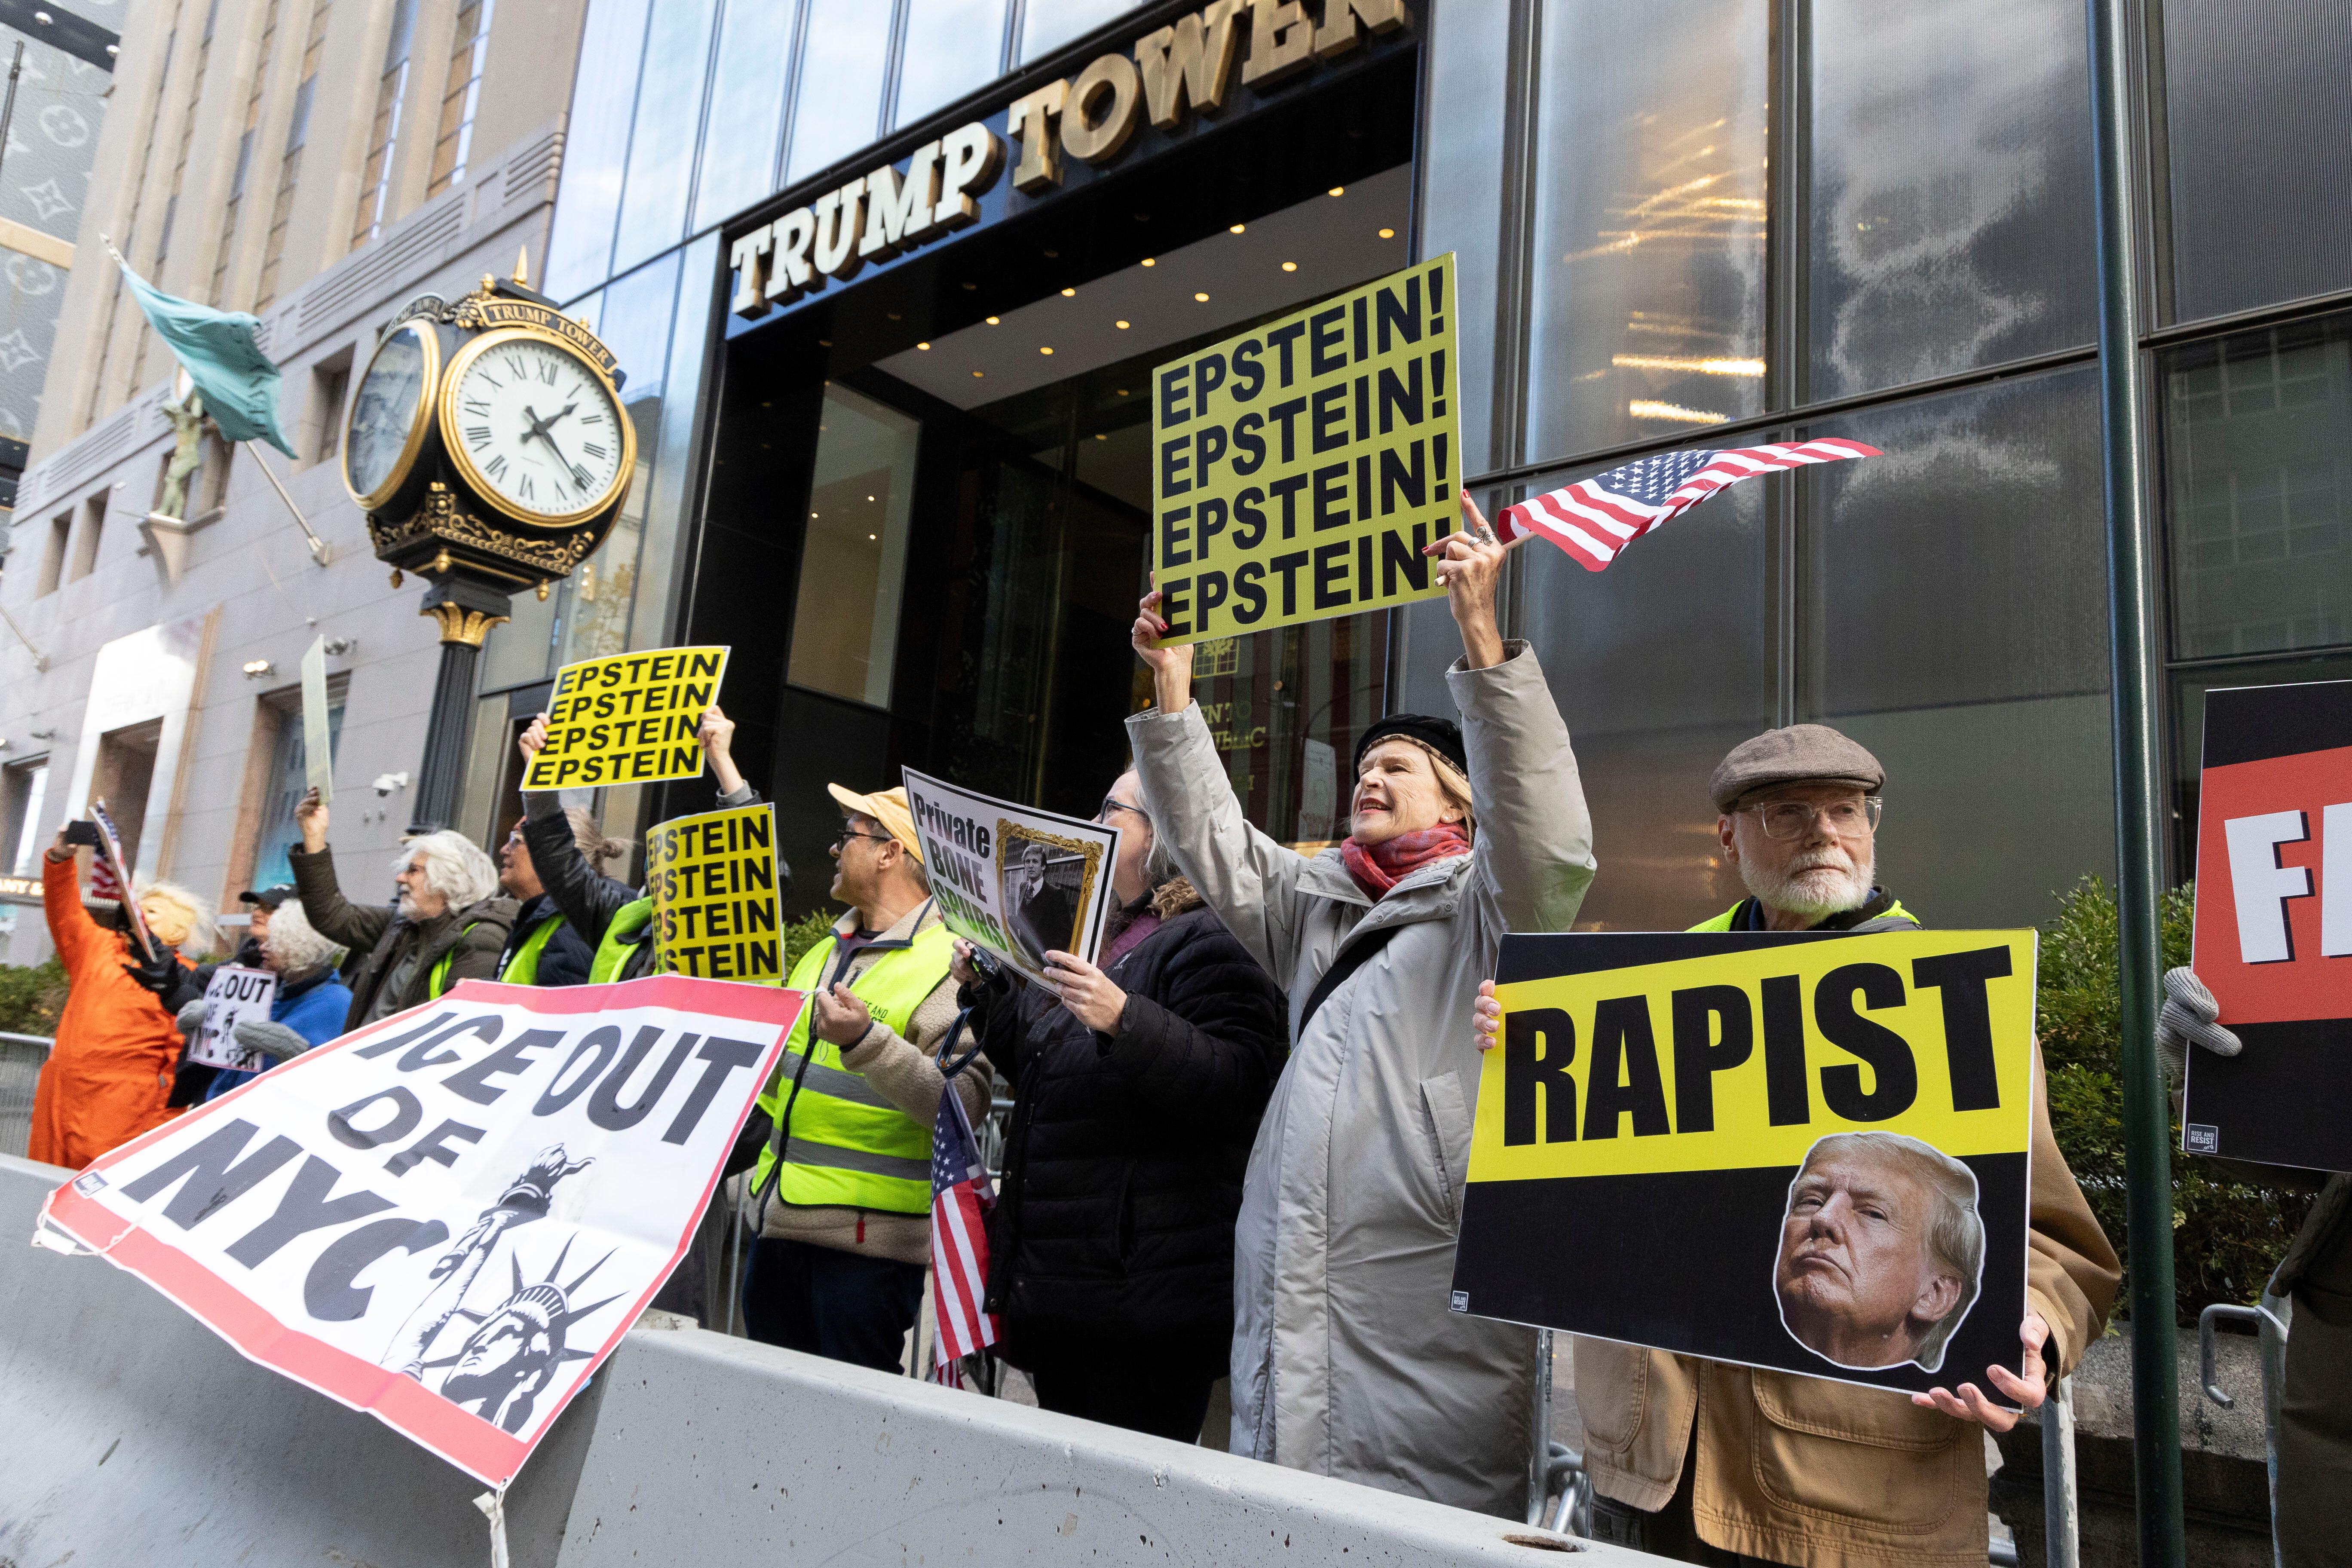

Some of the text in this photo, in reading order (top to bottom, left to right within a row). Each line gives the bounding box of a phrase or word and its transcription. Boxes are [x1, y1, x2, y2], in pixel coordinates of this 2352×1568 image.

[730, 122, 1004, 320] TRUMP
[488, 305, 610, 364] TRUMP TOWER
[1160, 266, 1444, 430] EPSTEIN!
[1161, 349, 1447, 499] EPSTEIN!
[1161, 432, 1449, 569] EPSTEIN!
[549, 683, 713, 725] EPSTEIN
[556, 653, 720, 696] EPSTEIN
[529, 745, 699, 786] EPSTEIN
[539, 713, 702, 756] EPSTEIN
[647, 814, 769, 869] EPSTEIN
[913, 791, 990, 859] Private
[29, 882, 45, 896] &
[927, 836, 988, 904] BONE
[933, 878, 1008, 952] SPURS
[225, 974, 271, 1003] OUT
[870, 1005, 888, 1018] AND
[353, 1012, 766, 1145] ICE OUT
[1504, 945, 2013, 1147] RAPIST
[328, 1086, 487, 1178] OF
[2191, 1136, 2214, 1144] RESIST
[120, 1118, 449, 1322] NYC
